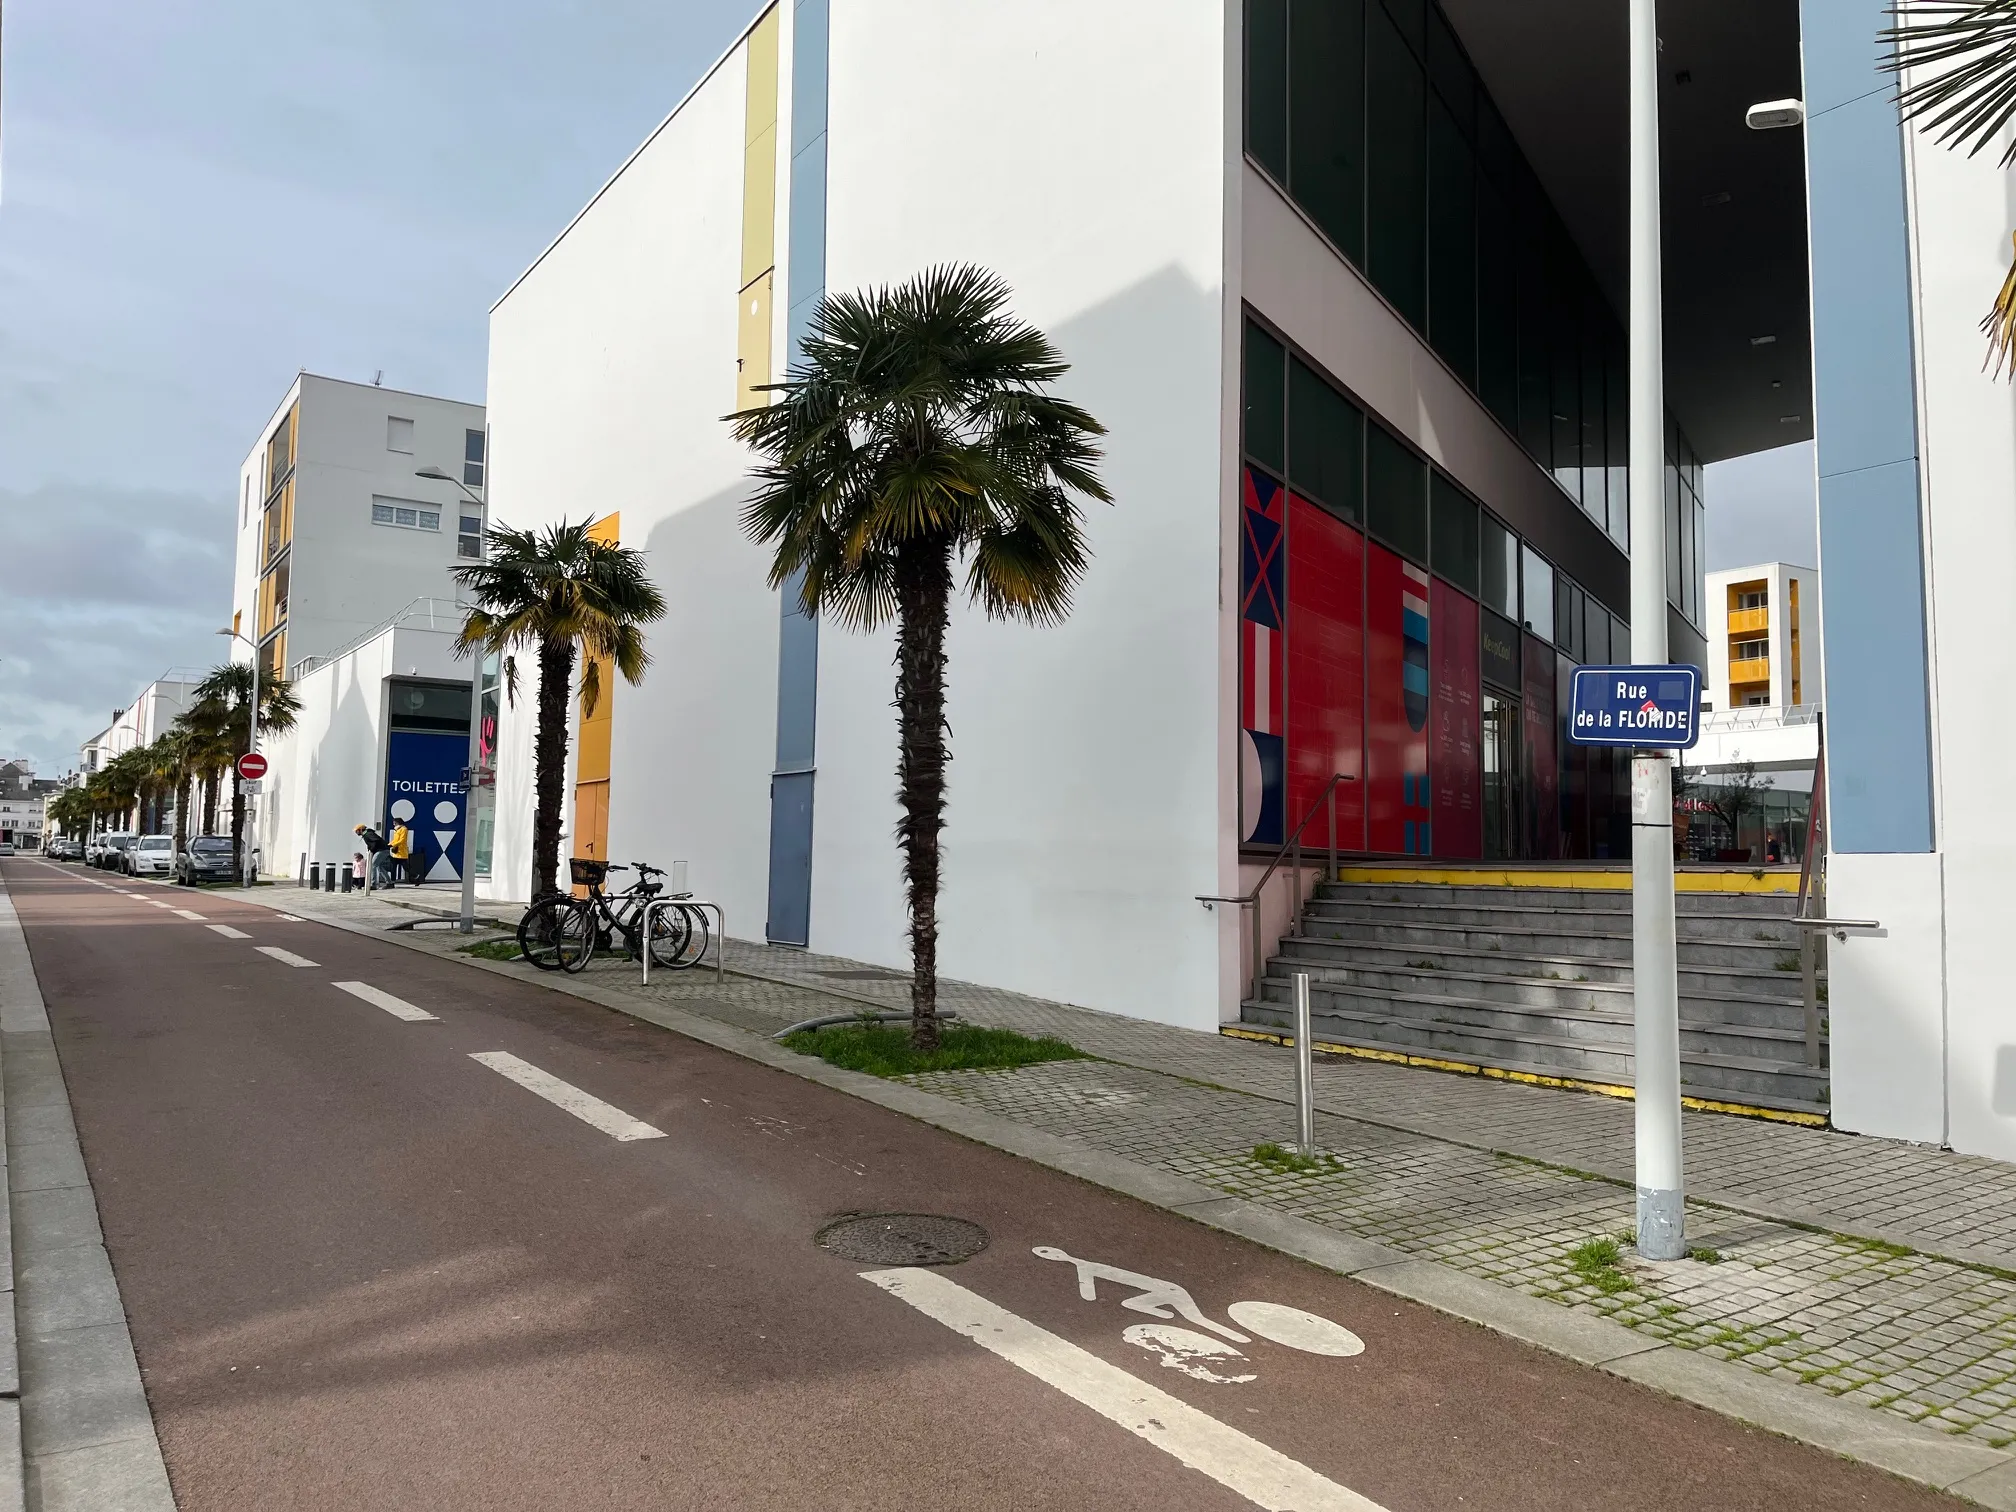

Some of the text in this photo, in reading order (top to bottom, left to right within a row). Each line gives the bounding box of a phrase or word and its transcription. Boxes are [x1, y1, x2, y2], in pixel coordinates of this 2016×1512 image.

[1616, 681, 1648, 699] Rue
[1576, 710, 1594, 727] de
[1598, 710, 1612, 728] la
